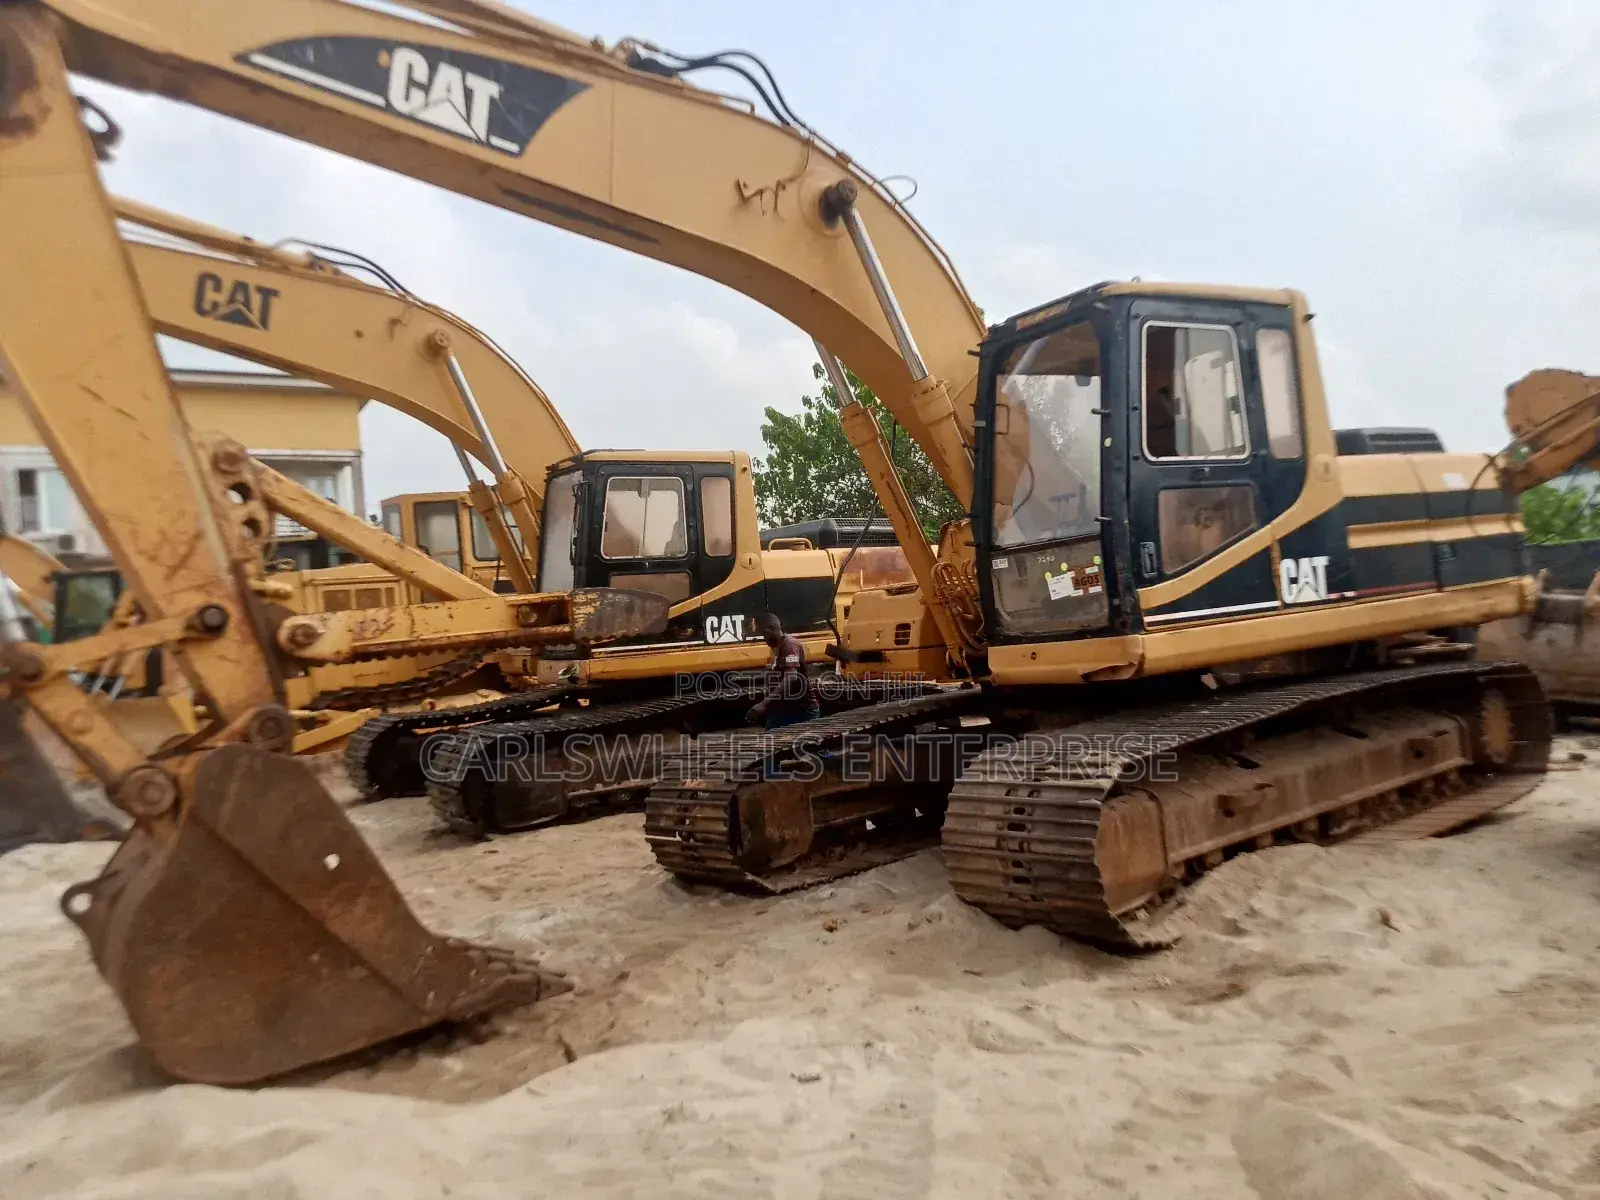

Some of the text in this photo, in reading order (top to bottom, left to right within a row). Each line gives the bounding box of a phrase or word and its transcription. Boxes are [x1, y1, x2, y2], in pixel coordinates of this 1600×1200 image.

[388, 47, 501, 142] CAT
[194, 272, 279, 330] CAT
[1279, 555, 1329, 604] CAT
[705, 615, 744, 643] CAT
